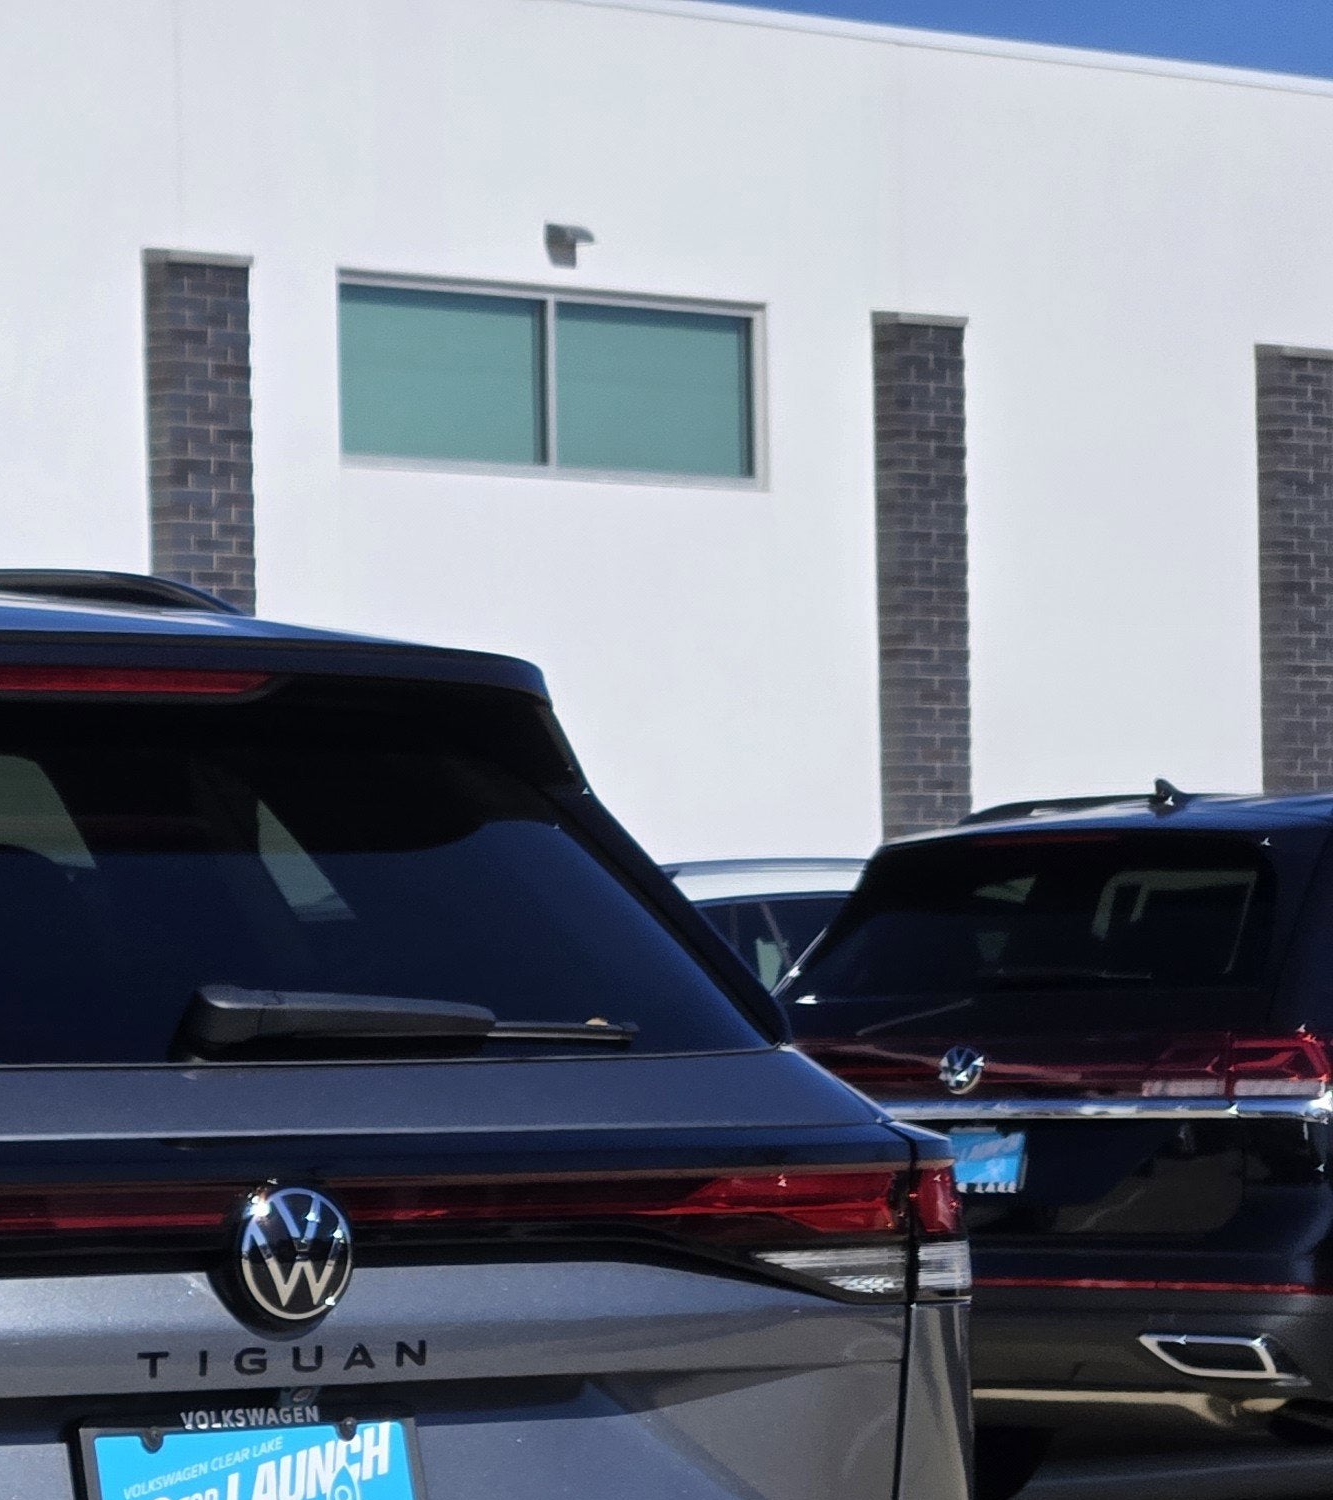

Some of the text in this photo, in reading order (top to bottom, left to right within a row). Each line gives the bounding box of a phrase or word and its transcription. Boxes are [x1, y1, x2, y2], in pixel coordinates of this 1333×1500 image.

[137, 1339, 428, 1379] TIGUAN
[180, 1405, 319, 1430] VOLKSWAGEN
[123, 1436, 284, 1500] VOLKSWAGEN CLEAR LAKE
